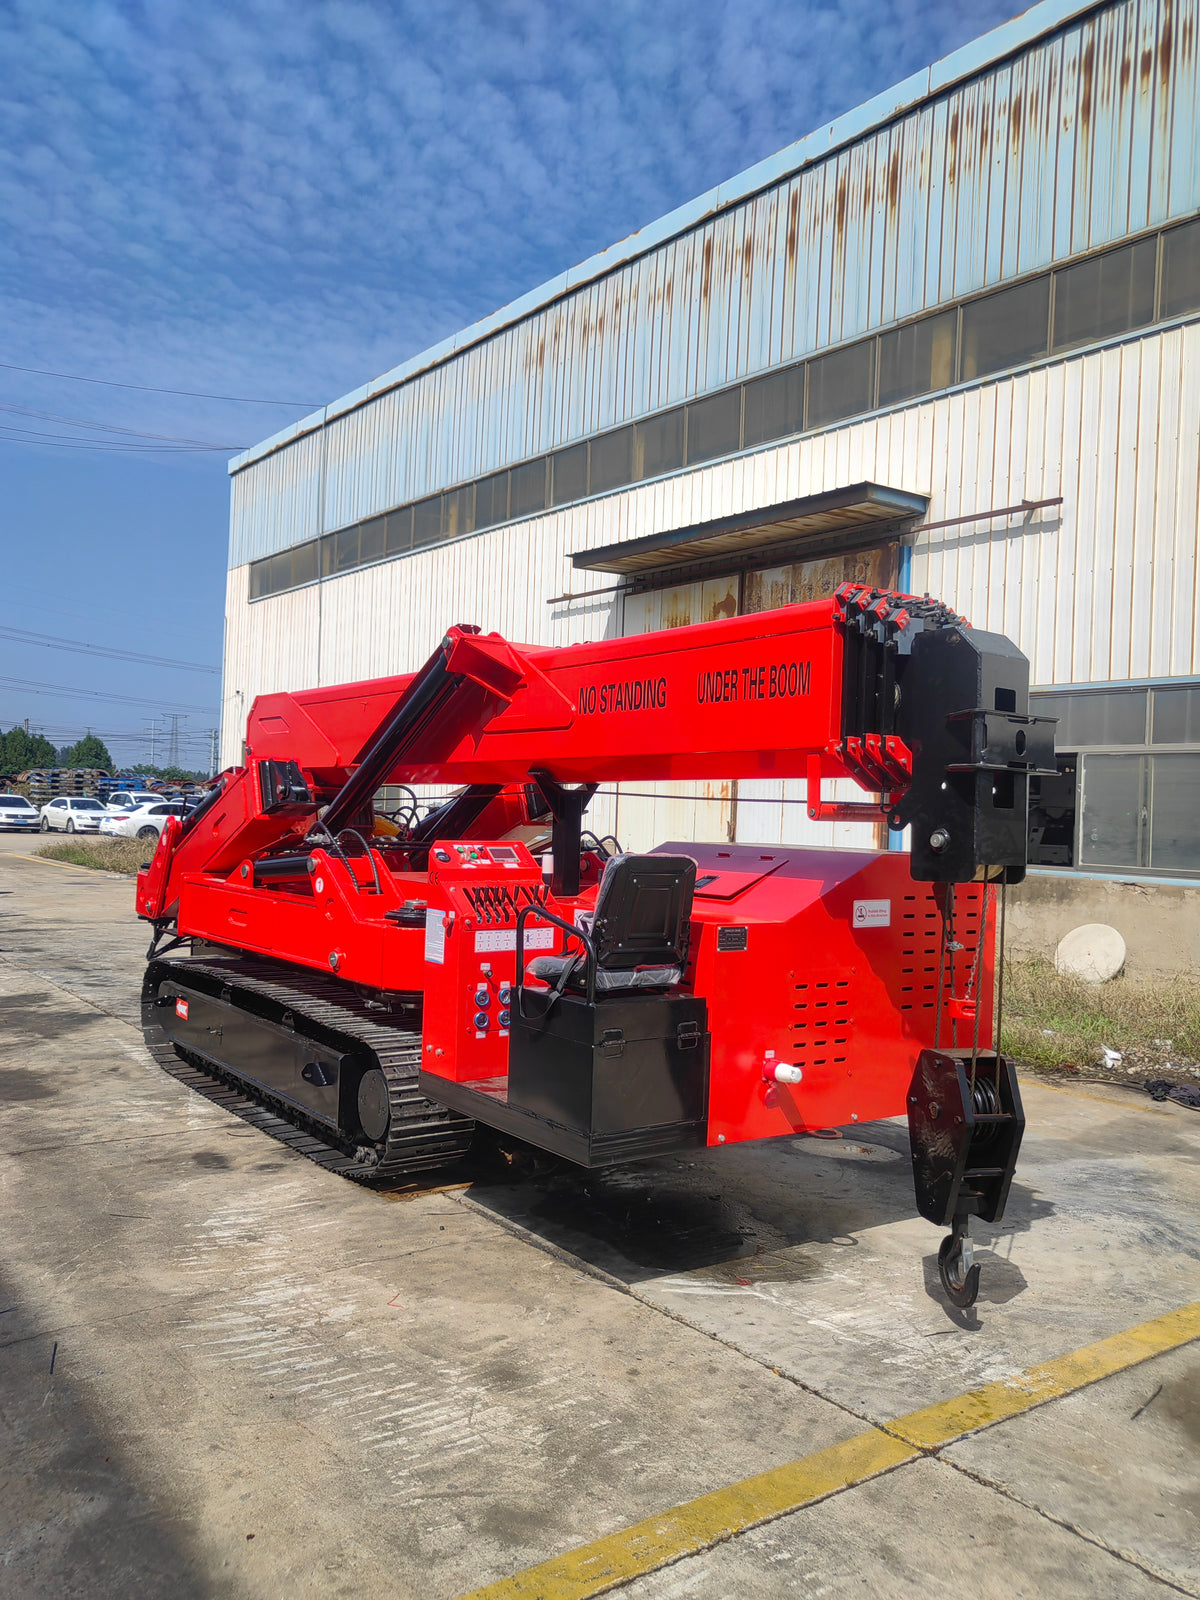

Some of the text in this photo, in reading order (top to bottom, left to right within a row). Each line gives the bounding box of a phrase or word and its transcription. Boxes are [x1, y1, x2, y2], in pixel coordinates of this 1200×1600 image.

[579, 661, 811, 715] NO STANDING UNDER THE BOOM
